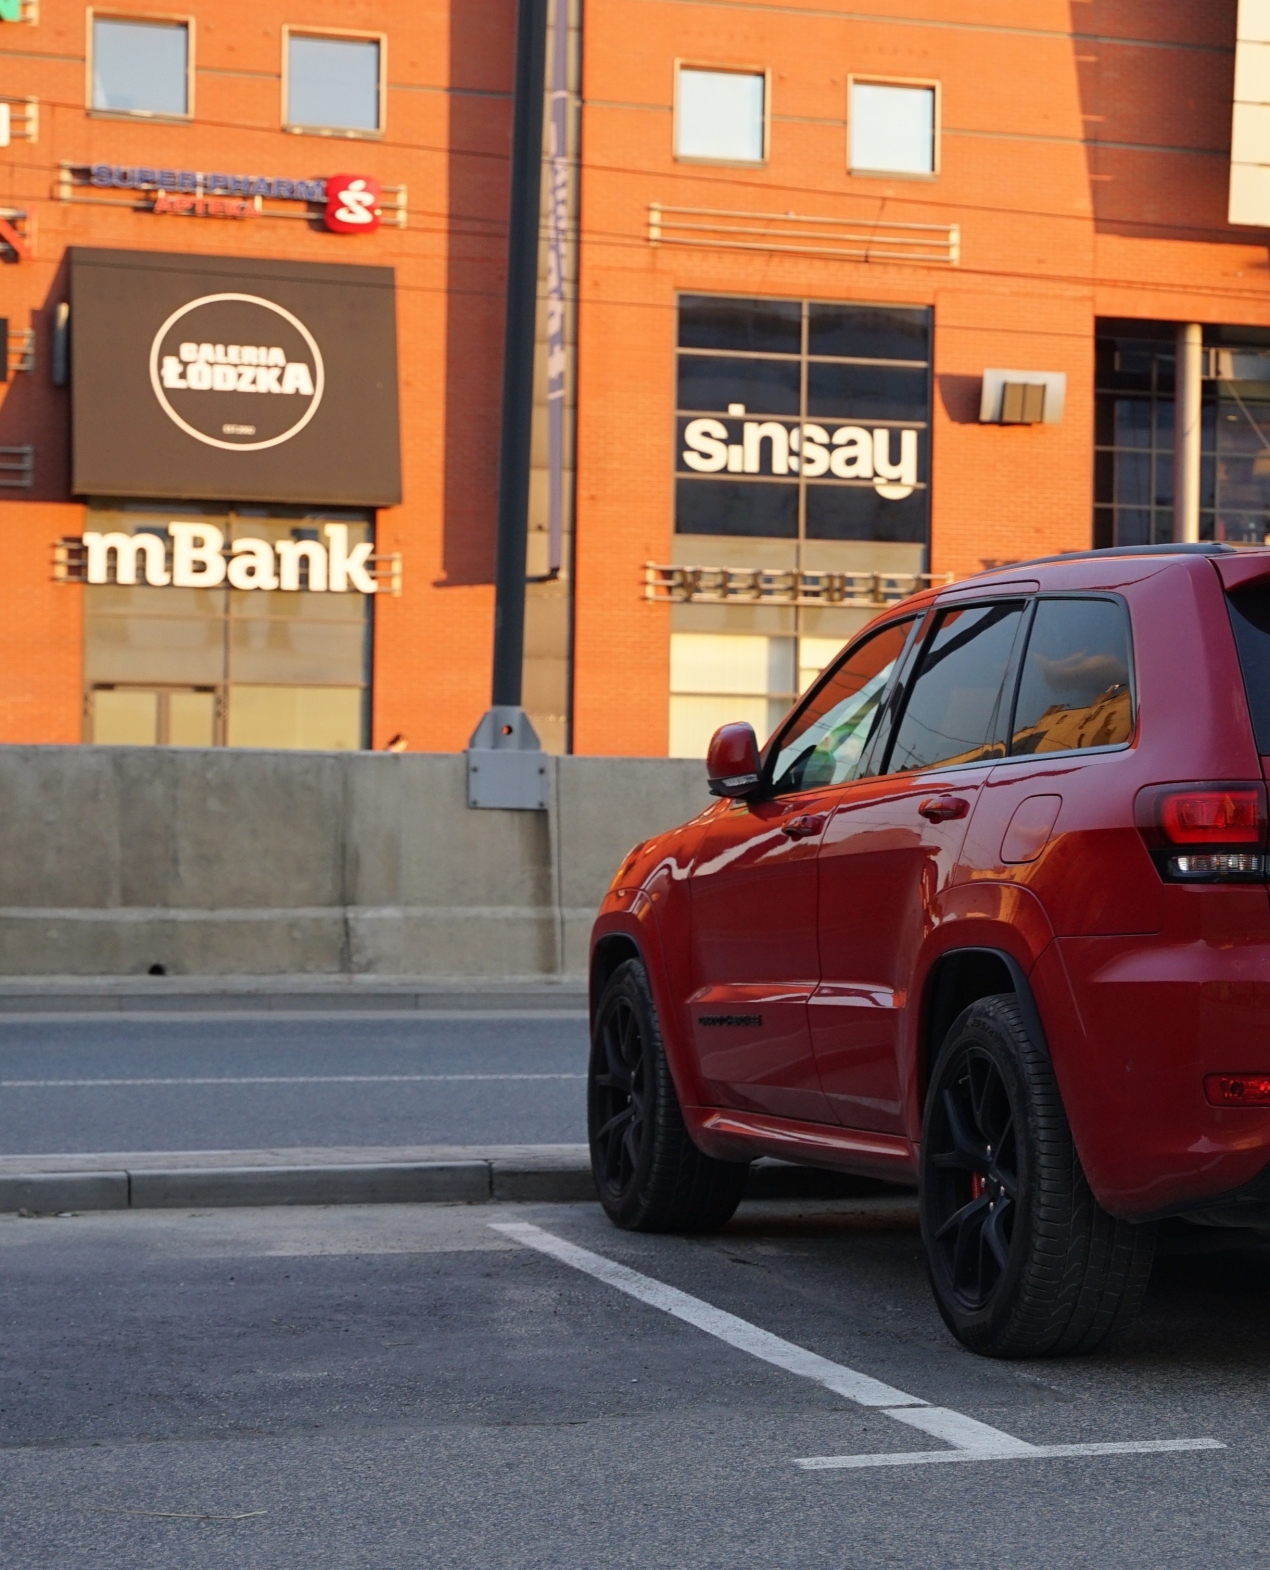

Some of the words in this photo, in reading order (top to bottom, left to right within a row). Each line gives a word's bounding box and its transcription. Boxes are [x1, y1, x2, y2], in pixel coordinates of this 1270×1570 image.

[155, 193, 261, 218] APTEKA
[179, 342, 287, 367] GALERIA
[682, 403, 918, 500] sinsay
[82, 520, 378, 594] mBank
